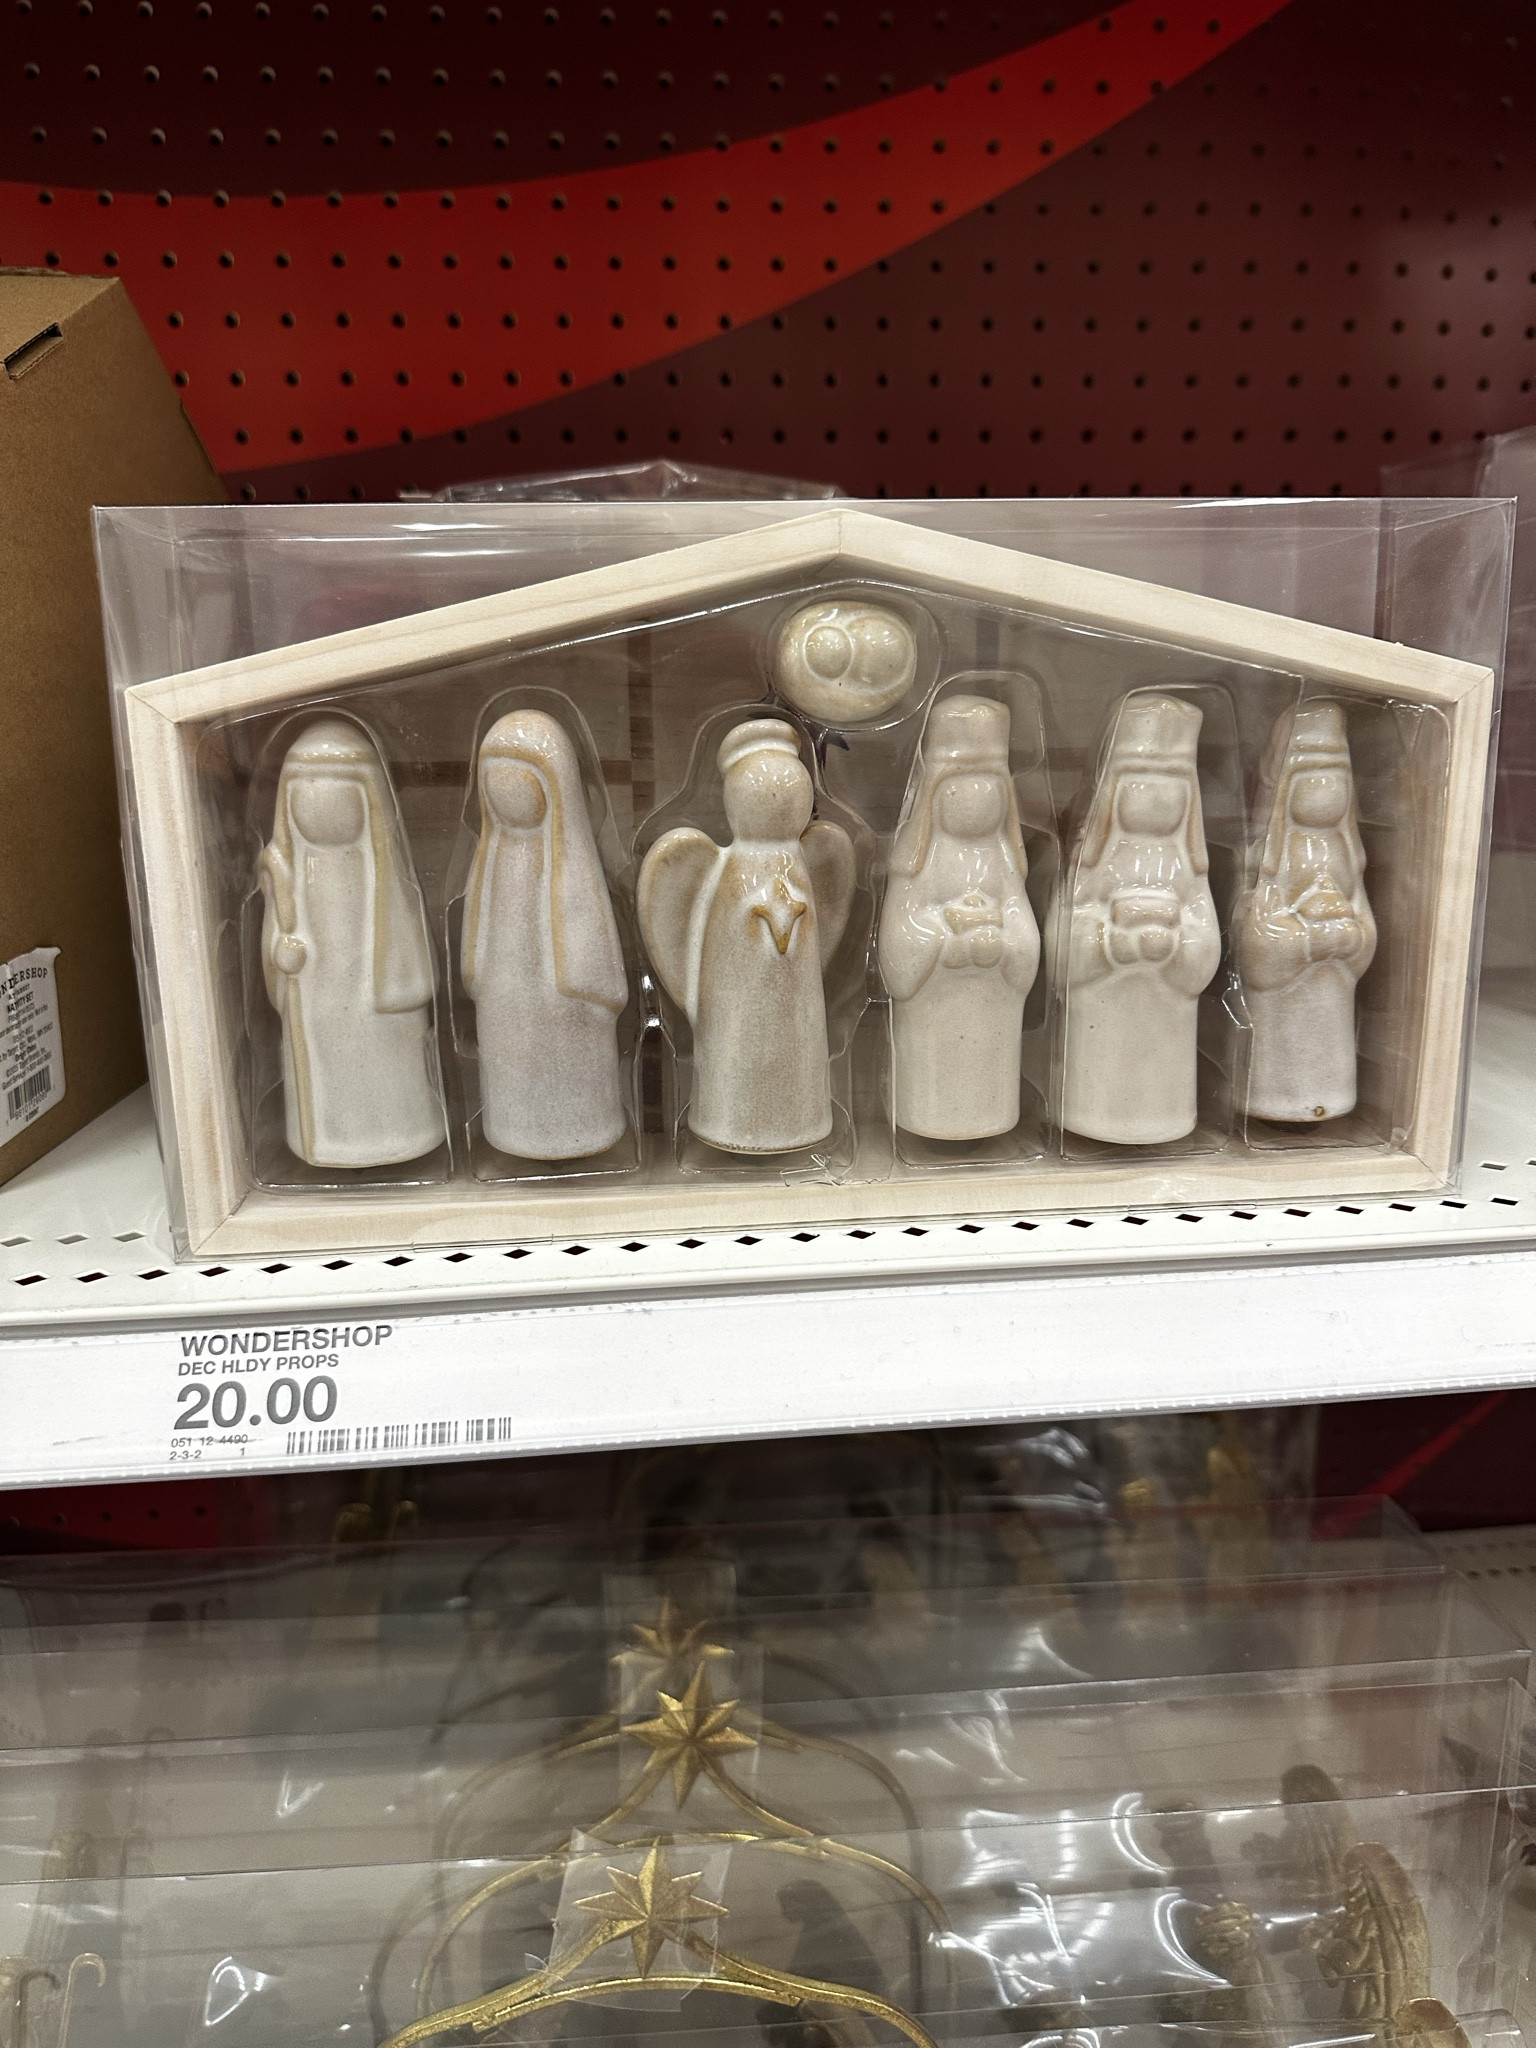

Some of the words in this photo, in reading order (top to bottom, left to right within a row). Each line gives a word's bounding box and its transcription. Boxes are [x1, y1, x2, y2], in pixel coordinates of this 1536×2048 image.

[0, 967, 48, 998] NDERSHOP
[181, 1324, 394, 1357] WONDERSHOP
[178, 1361, 216, 1376] DEC
[221, 1357, 272, 1374] HLDY
[276, 1353, 339, 1371] PROPS
[174, 1375, 338, 1430] 20.00
[169, 1449, 203, 1461] 2-3-2
[240, 1446, 246, 1457] 1
[170, 1437, 192, 1448] 051
[200, 1436, 214, 1447] 12
